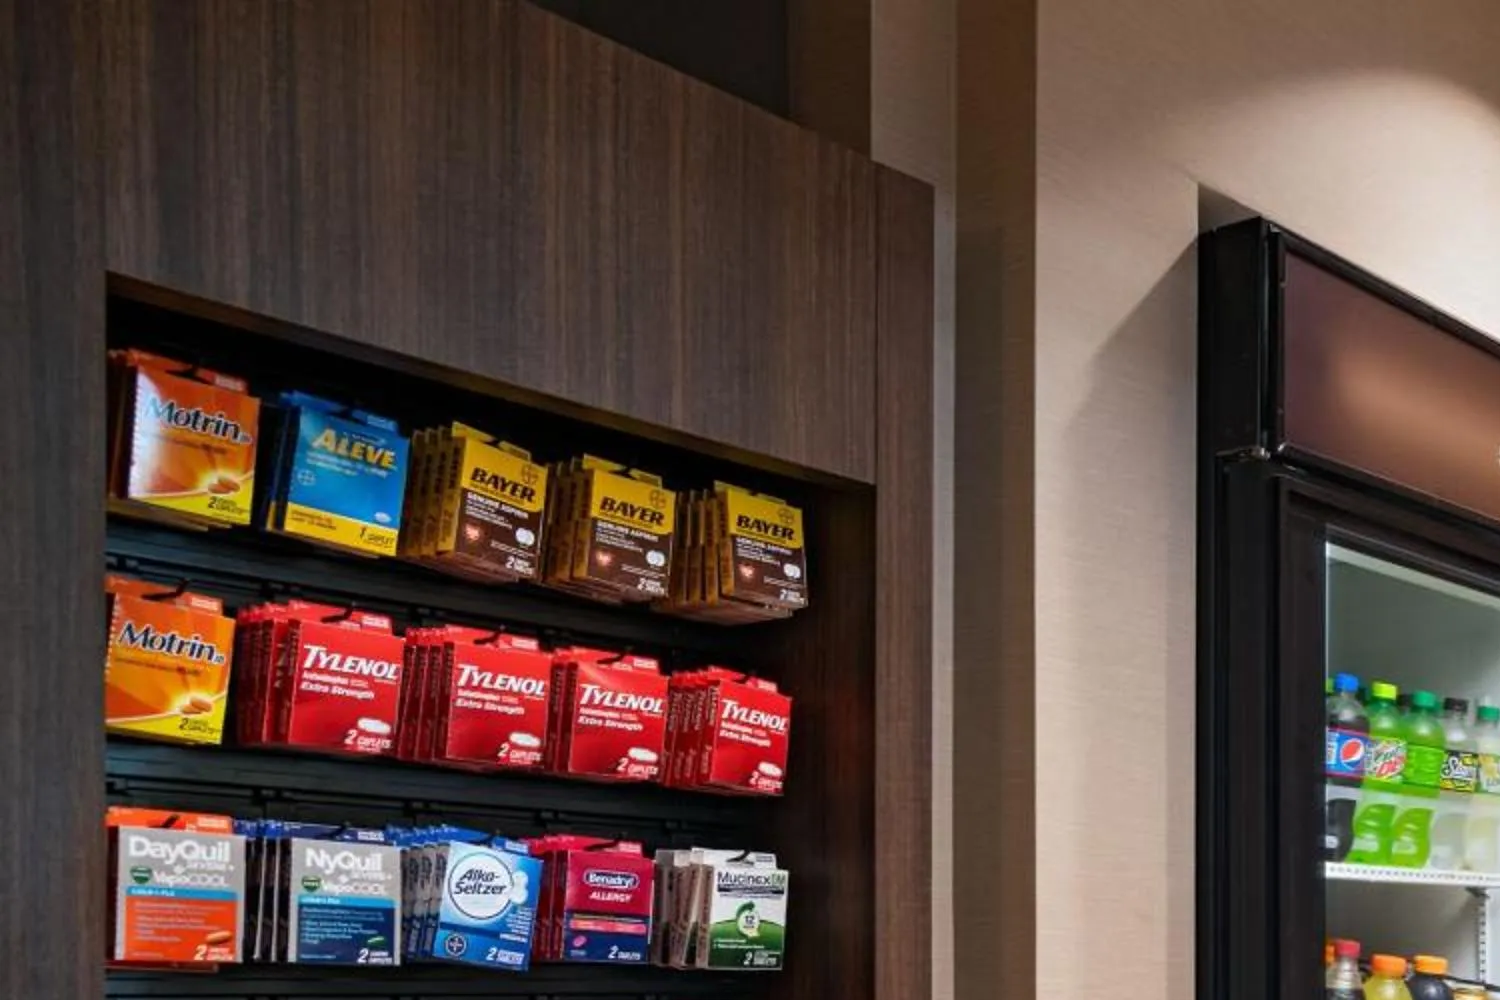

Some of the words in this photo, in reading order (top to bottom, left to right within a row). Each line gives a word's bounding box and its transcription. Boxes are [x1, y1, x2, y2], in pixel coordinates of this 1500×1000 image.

[147, 396, 241, 441] Motrin
[311, 427, 396, 469] ALEVE
[470, 466, 536, 503] BAYER
[599, 496, 665, 527] BAYER
[735, 513, 795, 541] BAYER
[118, 622, 214, 664] Motrin
[303, 645, 400, 681] TYLENOL
[456, 663, 545, 697] TYLENOL
[301, 680, 329, 695] Extra
[330, 685, 375, 700] Strength
[578, 683, 664, 715] TYLENOL
[178, 716, 189, 732] 2
[721, 699, 788, 732] TYLENOL
[344, 728, 355, 746] 2
[497, 742, 510, 758] 2
[616, 757, 628, 773] 2
[749, 770, 759, 785] 2
[129, 836, 231, 866] DayQuil
[305, 847, 383, 875] NyQuil
[460, 866, 500, 883] Alka-
[717, 870, 771, 887] Mucinex
[453, 880, 506, 899] Seltzer
[589, 890, 632, 903] ALLERGY
[193, 944, 206, 961] 2
[356, 948, 369, 964] 2
[486, 947, 497, 961] 2
[608, 945, 618, 960] 2
[743, 952, 754, 966] 2
